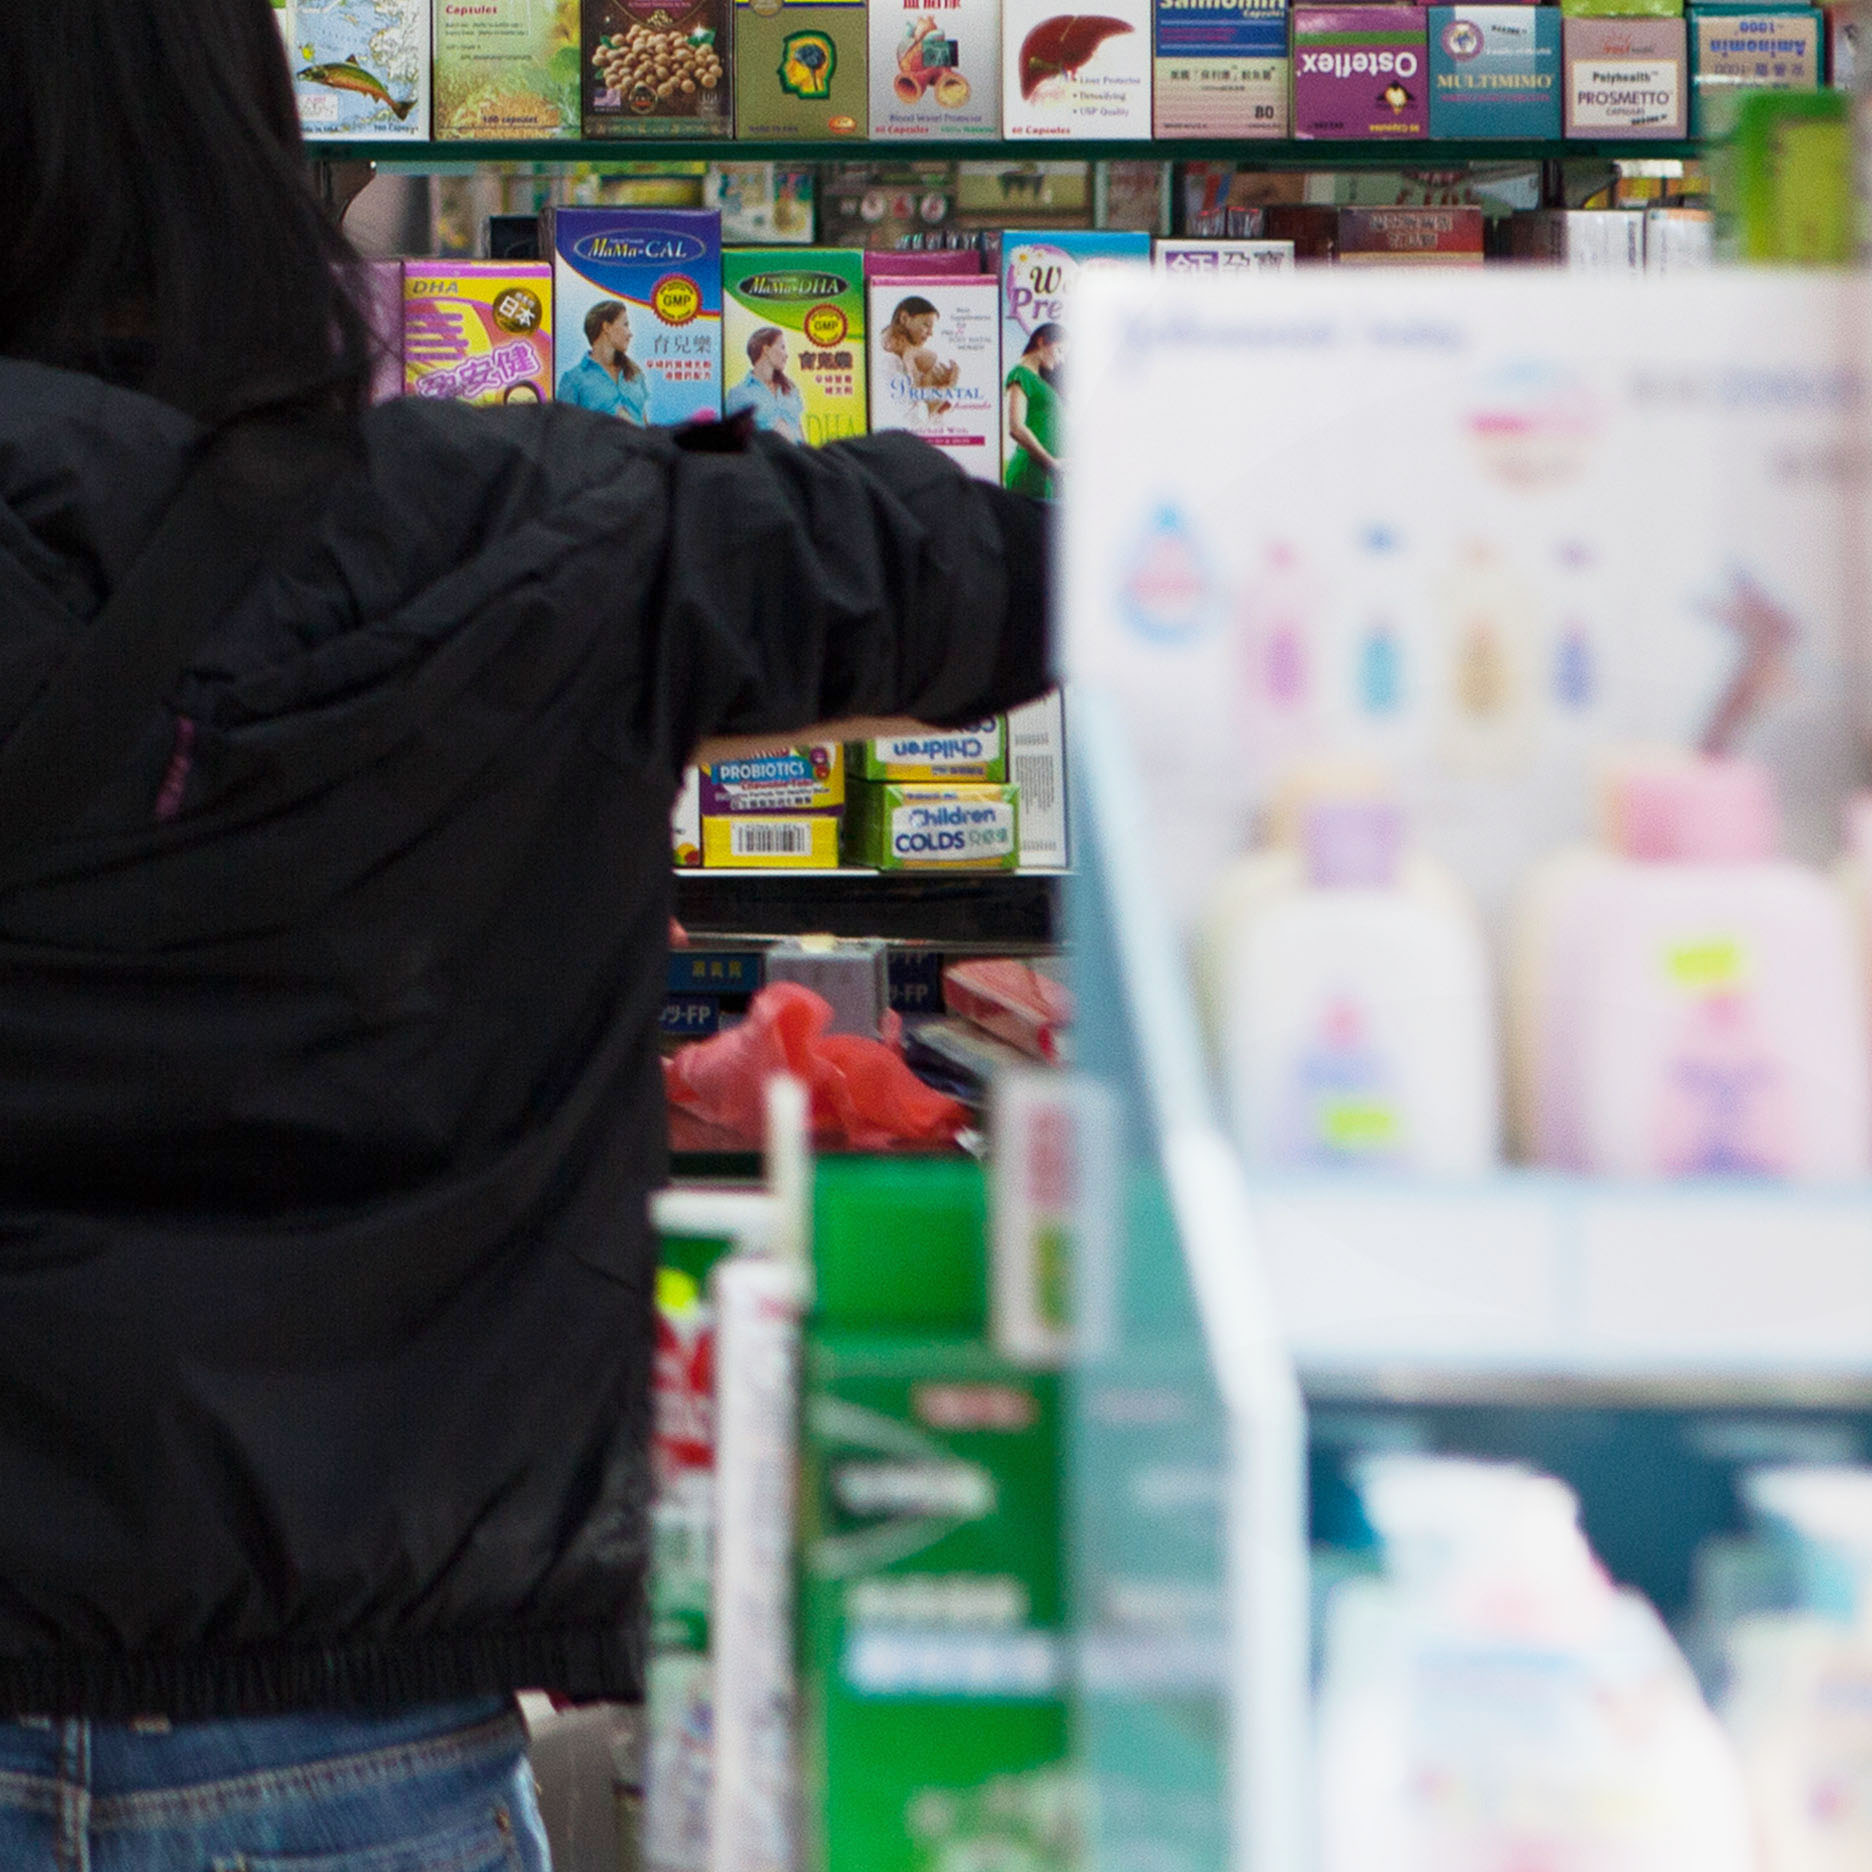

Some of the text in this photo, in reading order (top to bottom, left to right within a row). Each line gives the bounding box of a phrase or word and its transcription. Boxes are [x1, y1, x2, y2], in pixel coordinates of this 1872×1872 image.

[1302, 51, 1417, 77] Osteflex
[1578, 92, 1670, 106] PROSMETTO
[498, 292, 535, 326] 日本
[720, 761, 805, 781] PROBIOTICS
[909, 806, 996, 827] Children
[897, 832, 965, 852] COLDS
